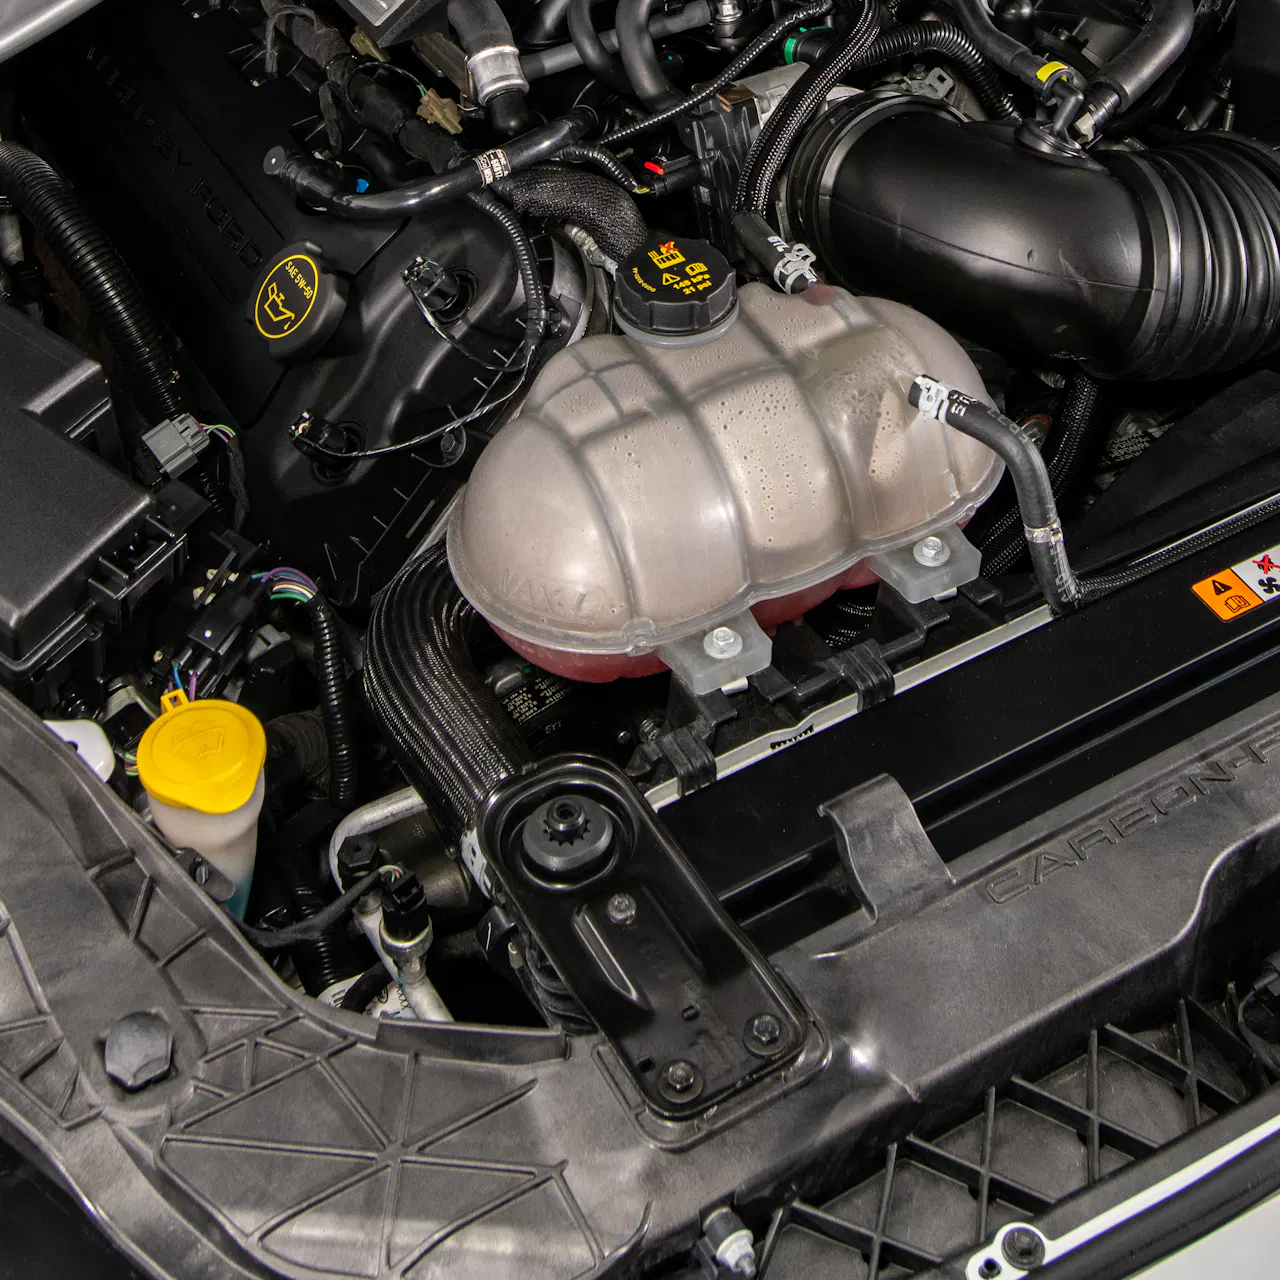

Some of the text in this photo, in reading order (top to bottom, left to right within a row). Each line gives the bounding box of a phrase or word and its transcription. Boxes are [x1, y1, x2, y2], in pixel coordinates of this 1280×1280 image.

[285, 261, 313, 299] SAE 5W-50
[672, 273, 711, 290] 145 kPa
[682, 280, 713, 295] 21 psi
